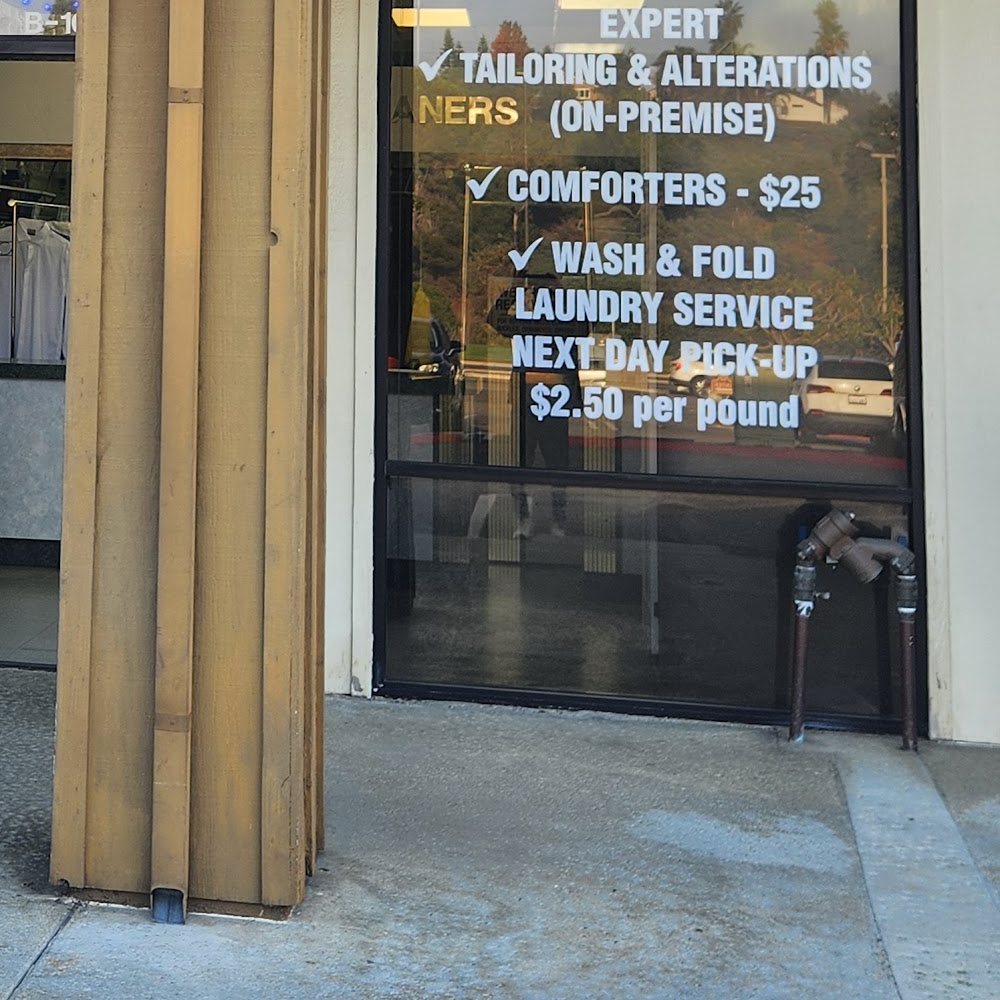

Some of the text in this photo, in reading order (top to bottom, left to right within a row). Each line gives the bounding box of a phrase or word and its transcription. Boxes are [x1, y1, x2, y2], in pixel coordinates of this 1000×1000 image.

[599, 7, 724, 40] EXPERT
[458, 52, 872, 90] TAILORING & ALTERATIONS
[549, 99, 777, 142] (ON-PREMISE)
[507, 169, 727, 207] COMFORTERS
[759, 173, 822, 212] $25
[550, 240, 776, 280] WASH & FOLD
[515, 287, 664, 325] LAUNDRY
[672, 291, 815, 331] SERVICE
[511, 334, 819, 380] NEXT DAY PICK-UP
[529, 382, 800, 432] $2.50 per pound
